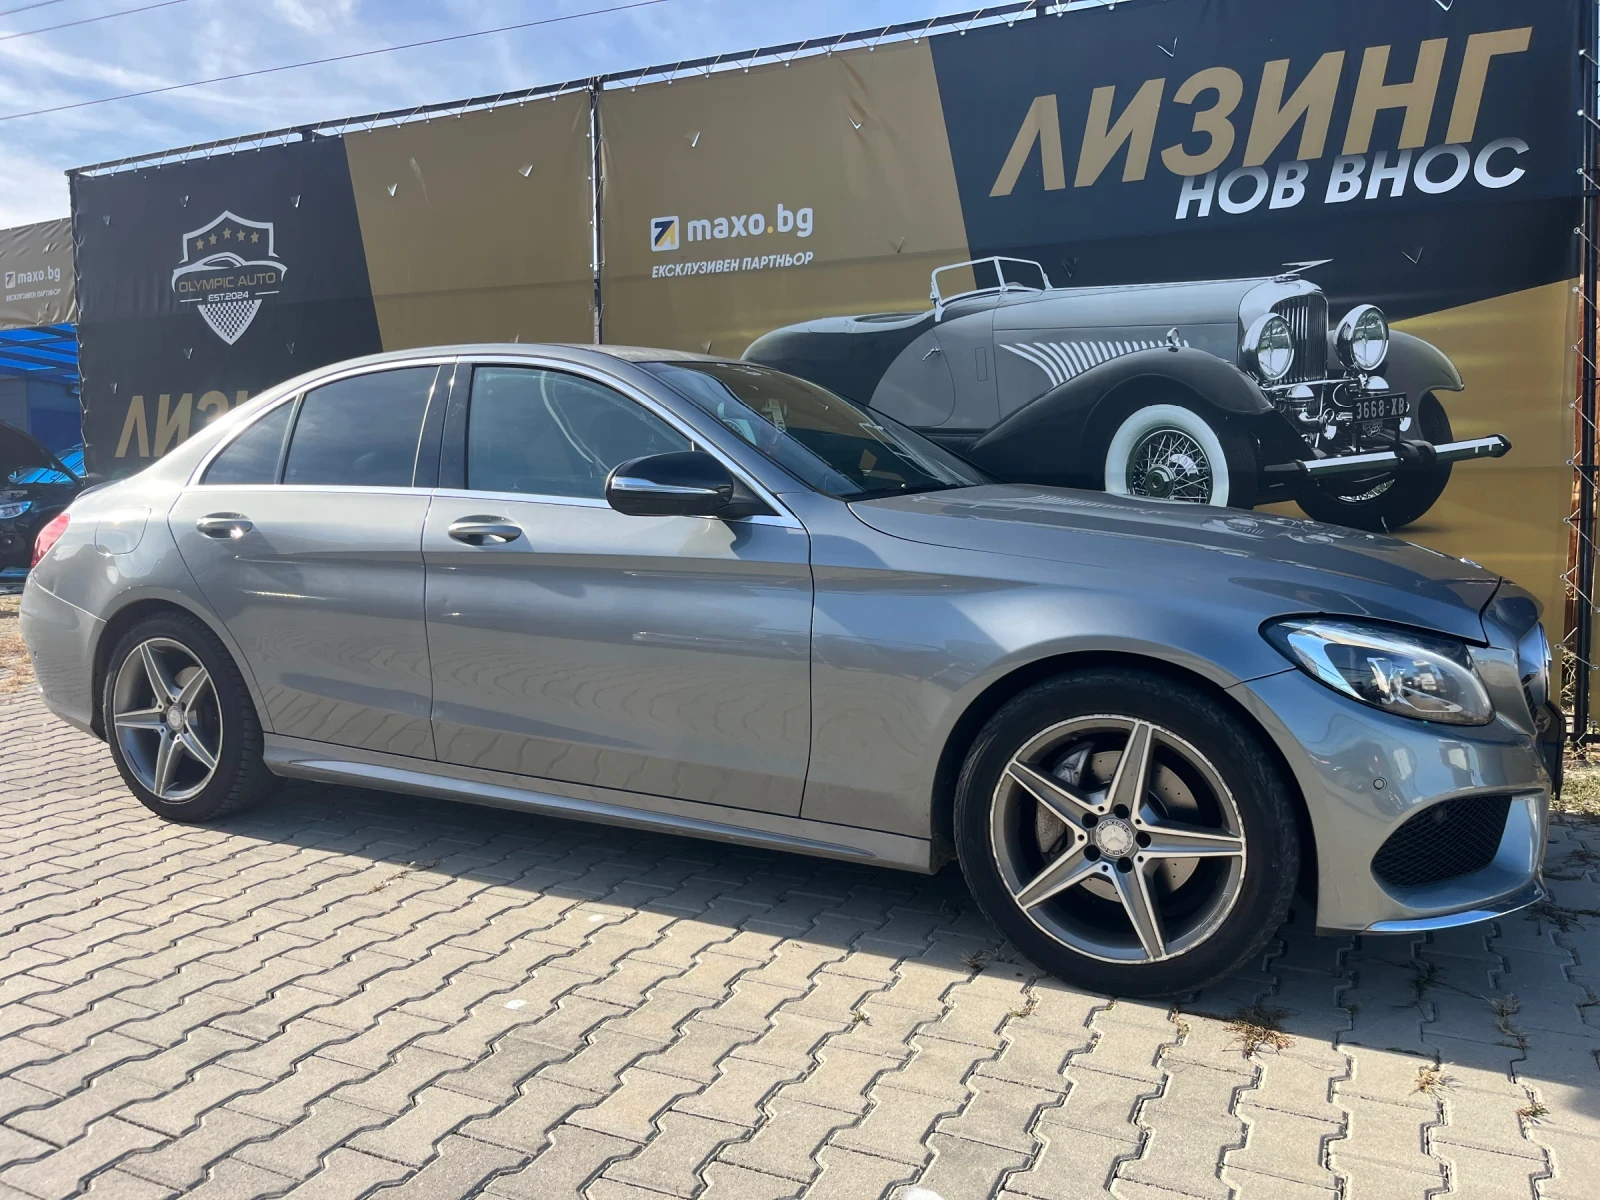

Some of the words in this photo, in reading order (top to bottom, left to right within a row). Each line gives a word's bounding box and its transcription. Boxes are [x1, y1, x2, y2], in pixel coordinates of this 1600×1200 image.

[989, 27, 1532, 197] ЛИЗИНГ
[1175, 161, 1306, 219] НОВ
[1325, 137, 1529, 203] ВНОС
[688, 203, 813, 242] maxo.bg
[17, 265, 61, 284] maxo.bg
[651, 258, 740, 279] ЕКСКЛУЗИВЕН
[742, 251, 814, 271] ПАРТНЬОР
[179, 276, 235, 292] OLYMPIC
[238, 272, 276, 287] AUTO
[208, 291, 249, 302] EST.2024
[1356, 397, 1405, 420] 3668-XB
